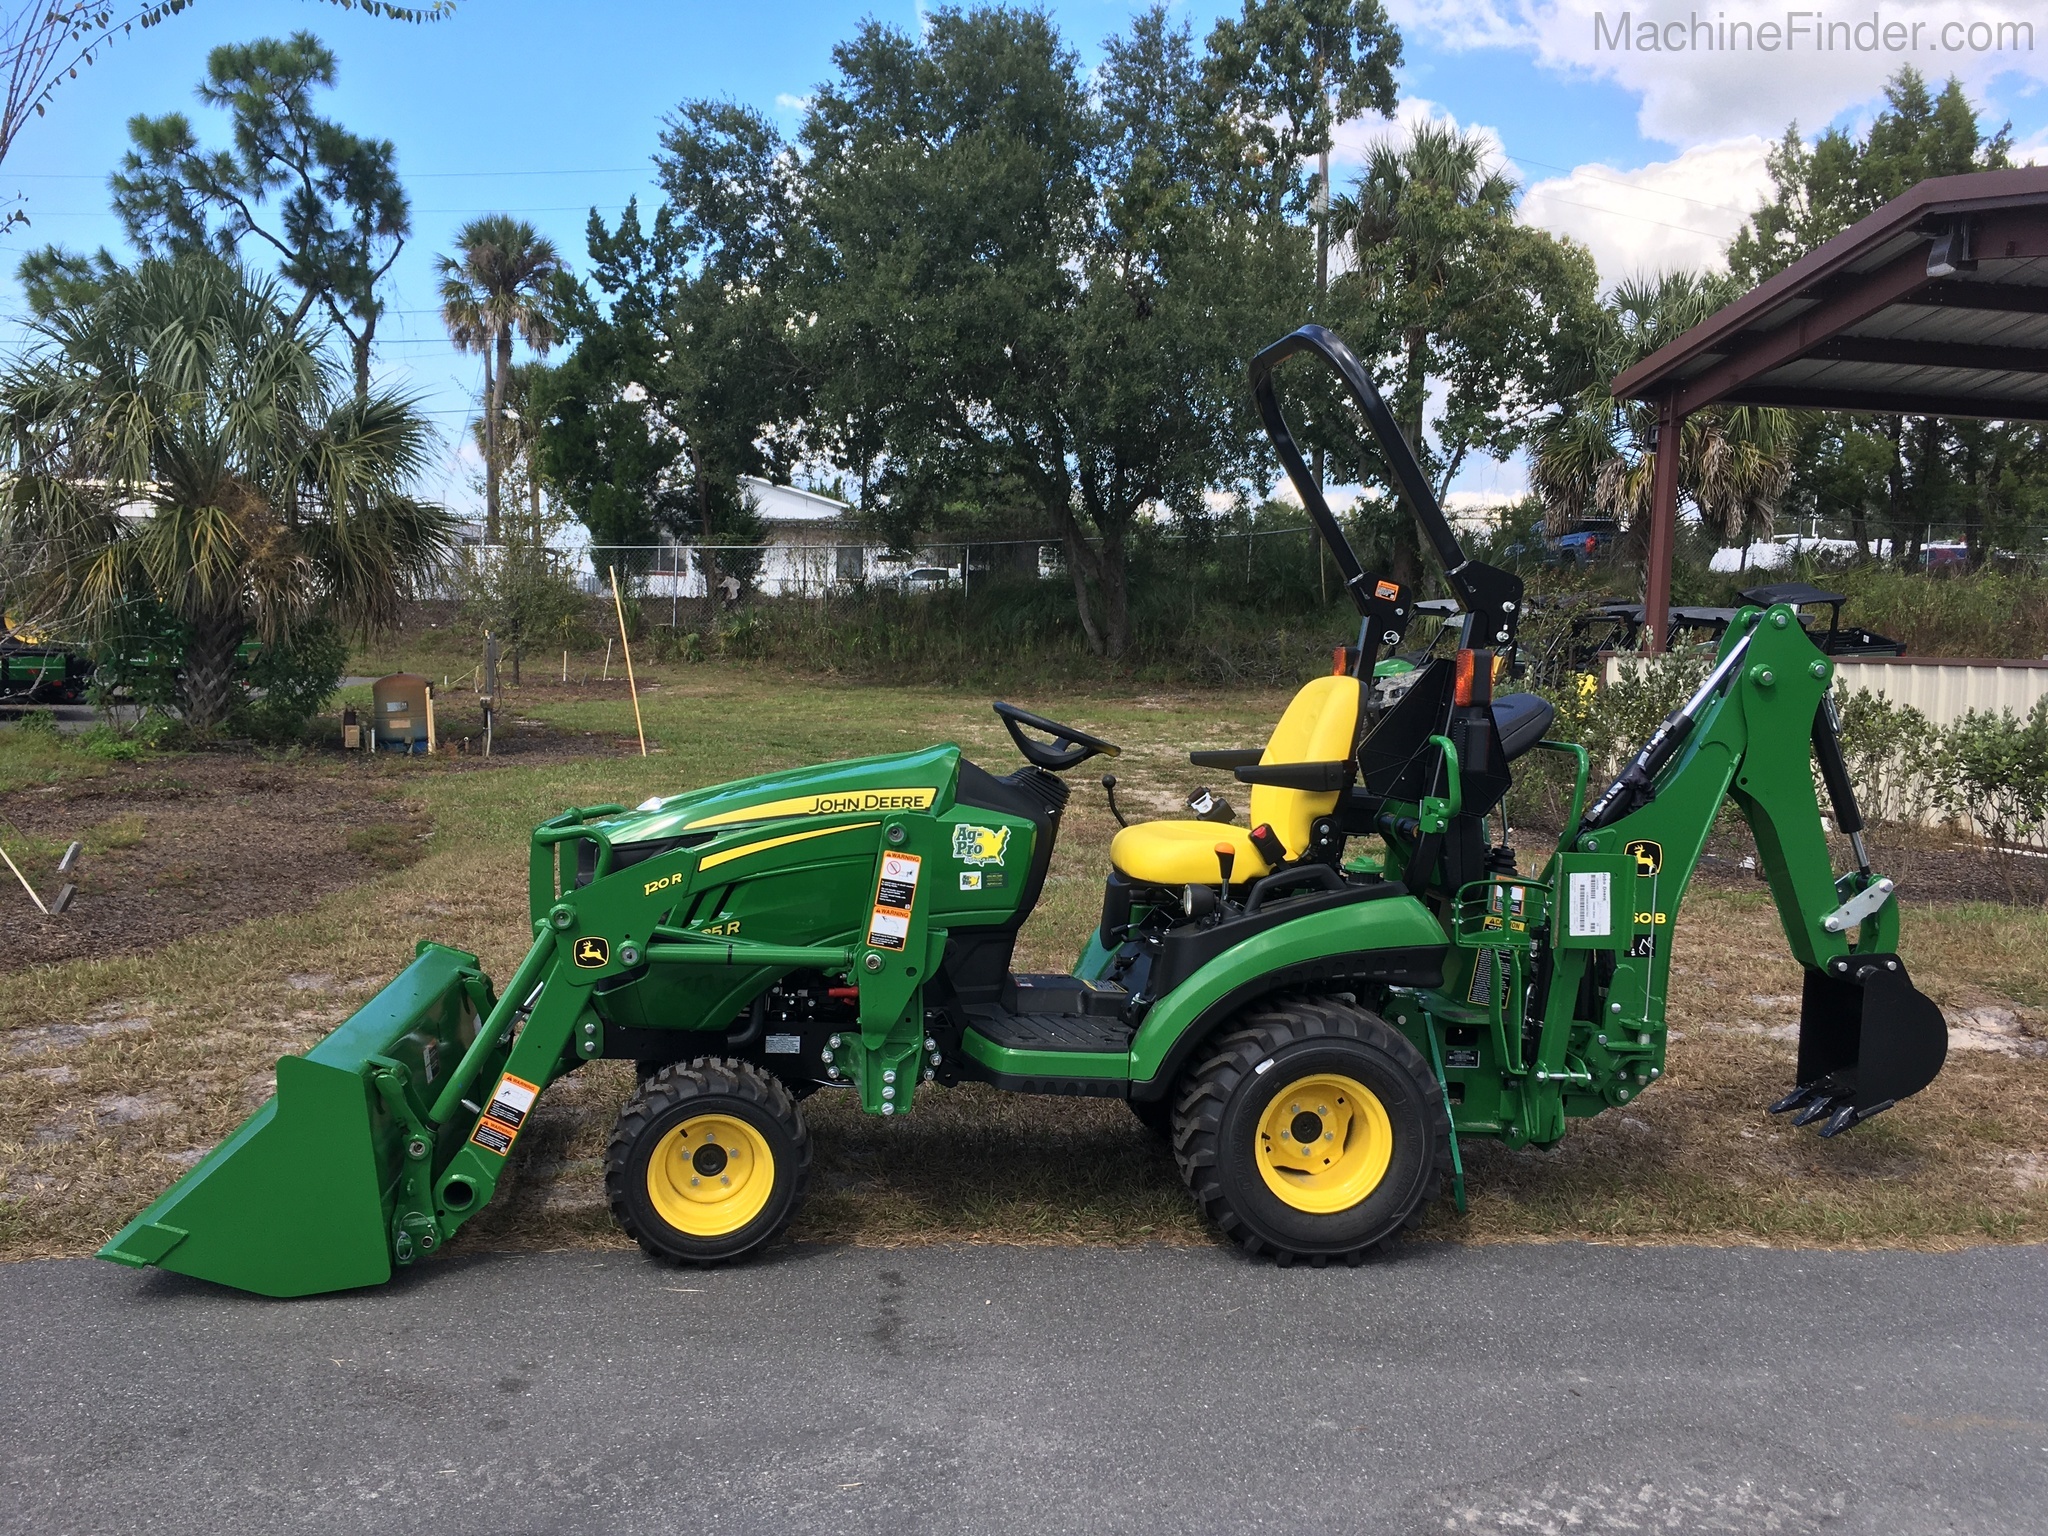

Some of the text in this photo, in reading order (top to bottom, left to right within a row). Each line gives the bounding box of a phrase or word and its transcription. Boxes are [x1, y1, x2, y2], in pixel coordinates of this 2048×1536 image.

[809, 794, 924, 812] JOHN DEERE
[956, 826, 983, 844] Ag-
[956, 841, 983, 855] Pro
[892, 852, 920, 862] WARNING
[644, 877, 670, 896] 120
[881, 909, 909, 918] WARNING
[512, 1076, 535, 1092] WARNING
[489, 1122, 513, 1137] WARNING
